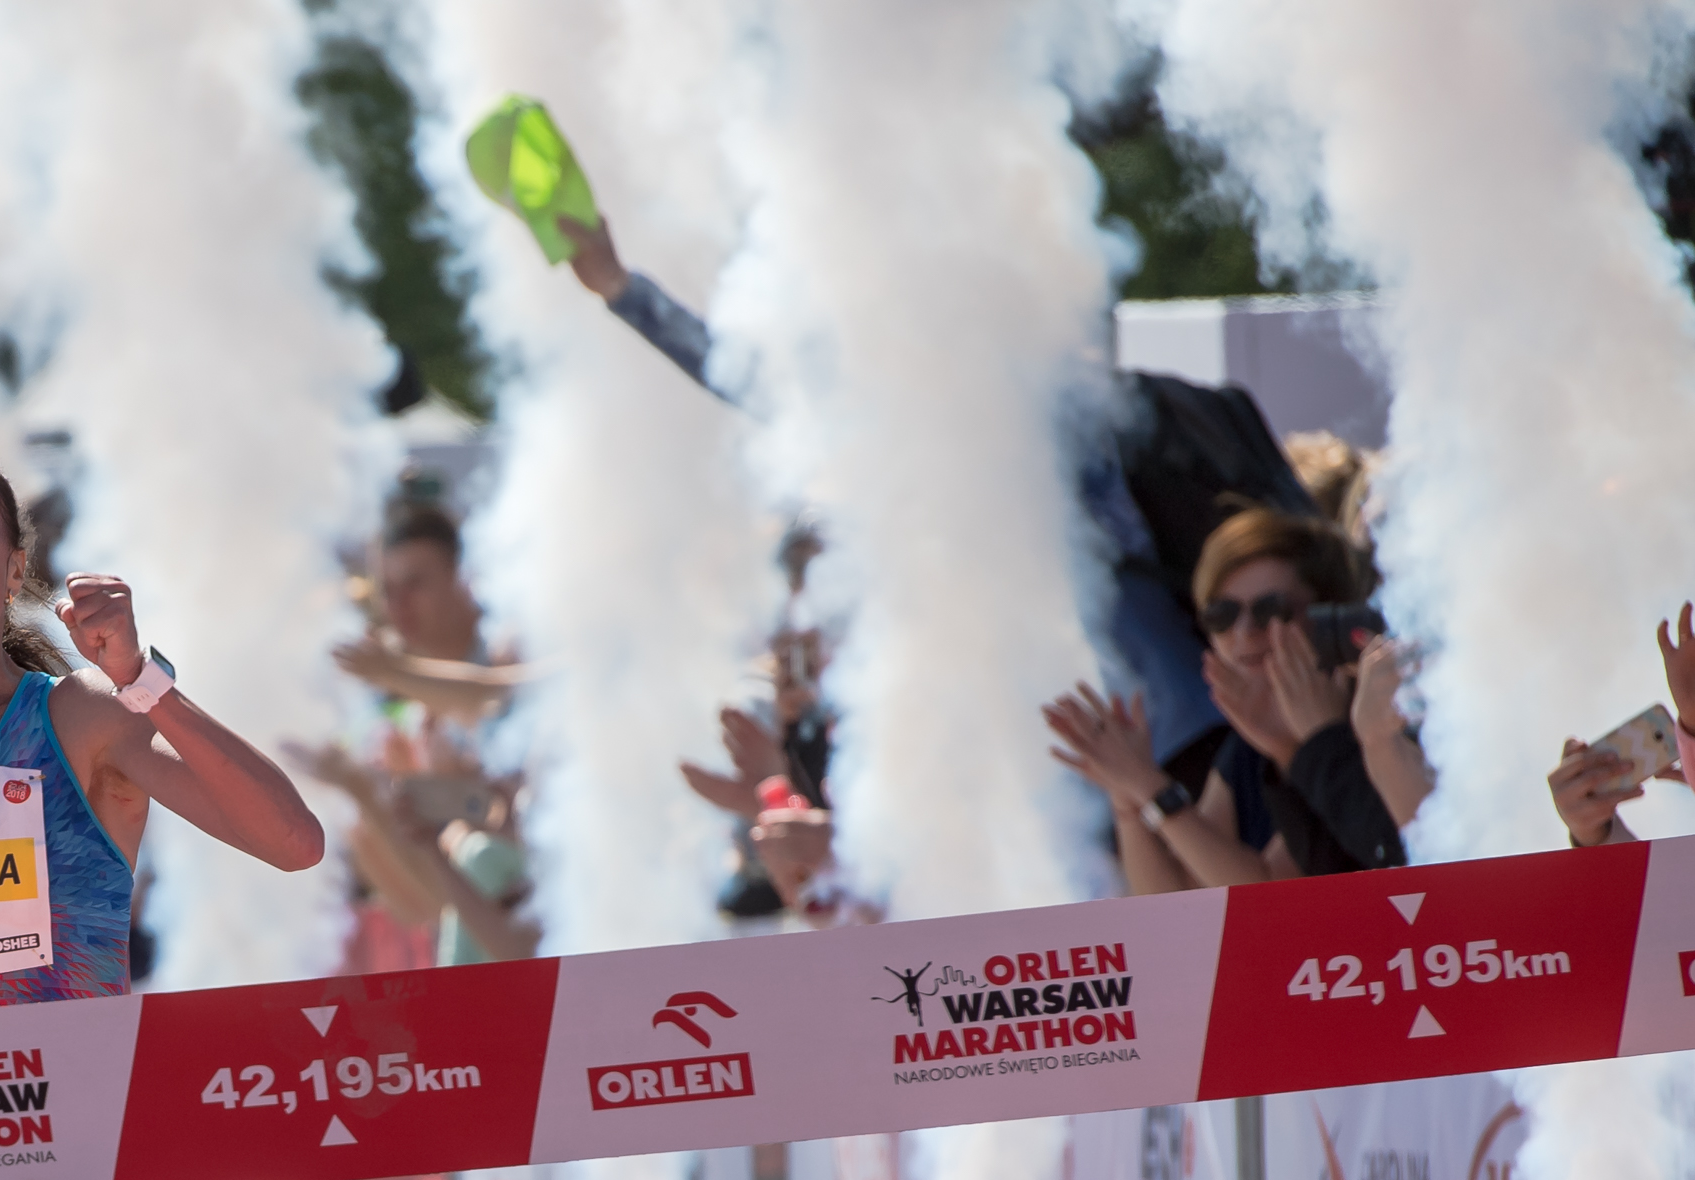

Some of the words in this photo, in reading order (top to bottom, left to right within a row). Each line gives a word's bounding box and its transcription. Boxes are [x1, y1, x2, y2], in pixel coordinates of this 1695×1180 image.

[5, 790, 26, 800] 2018
[983, 943, 1127, 985] ORLEN
[942, 976, 1132, 1024] WARSAW
[894, 1010, 1137, 1064] MARATHON
[597, 1060, 744, 1103] ORLEN
[894, 1062, 994, 1085] NARODOWE
[998, 1056, 1059, 1074] ŚWIĘTO
[1062, 1047, 1141, 1068] BIEGANIA
